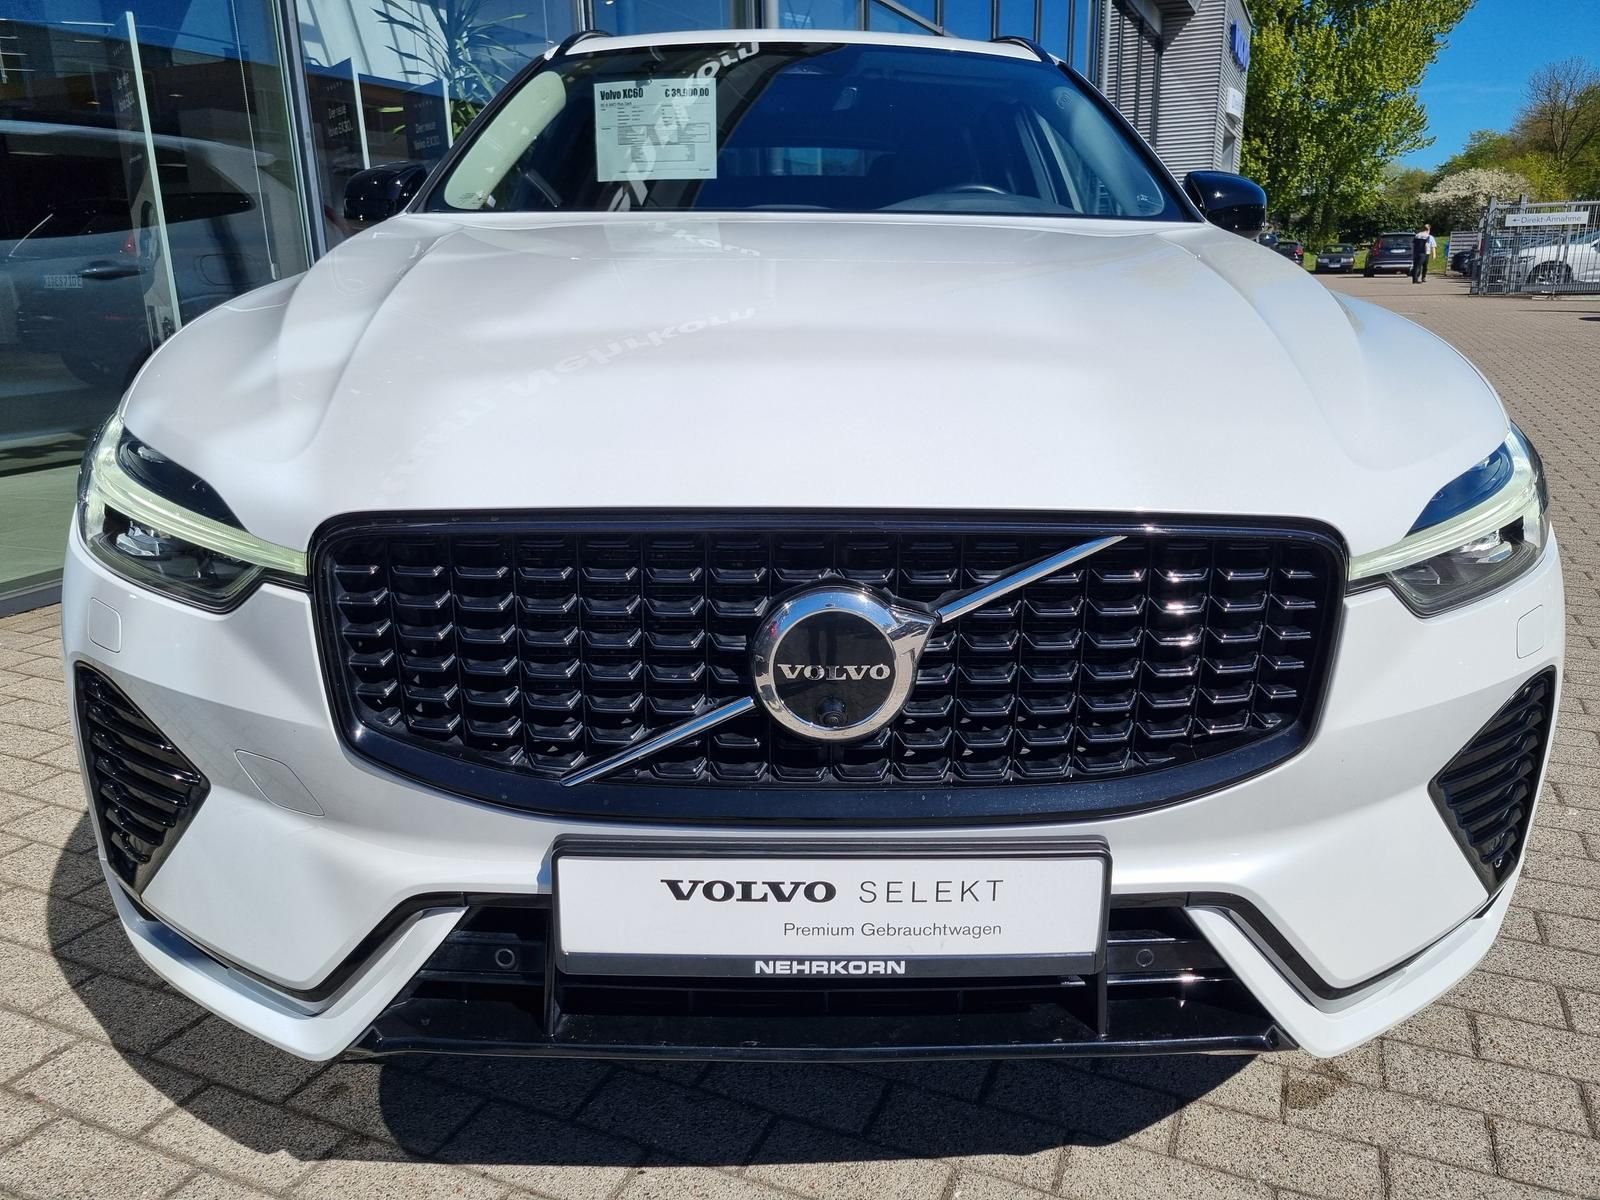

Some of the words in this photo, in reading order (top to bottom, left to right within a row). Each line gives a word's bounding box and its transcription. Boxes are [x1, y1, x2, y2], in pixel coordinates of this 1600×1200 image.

[600, 90, 622, 100] Volvo
[622, 88, 644, 99] XC60
[1521, 215, 1581, 224] Direkt-Annahme
[777, 664, 891, 681] VOLVO
[660, 878, 837, 904] VOLVO
[858, 878, 1005, 904] SELEKT
[783, 922, 855, 937] Premium
[860, 922, 1002, 940] Gebrauchtwagen
[754, 960, 906, 976] NEHRKORN
